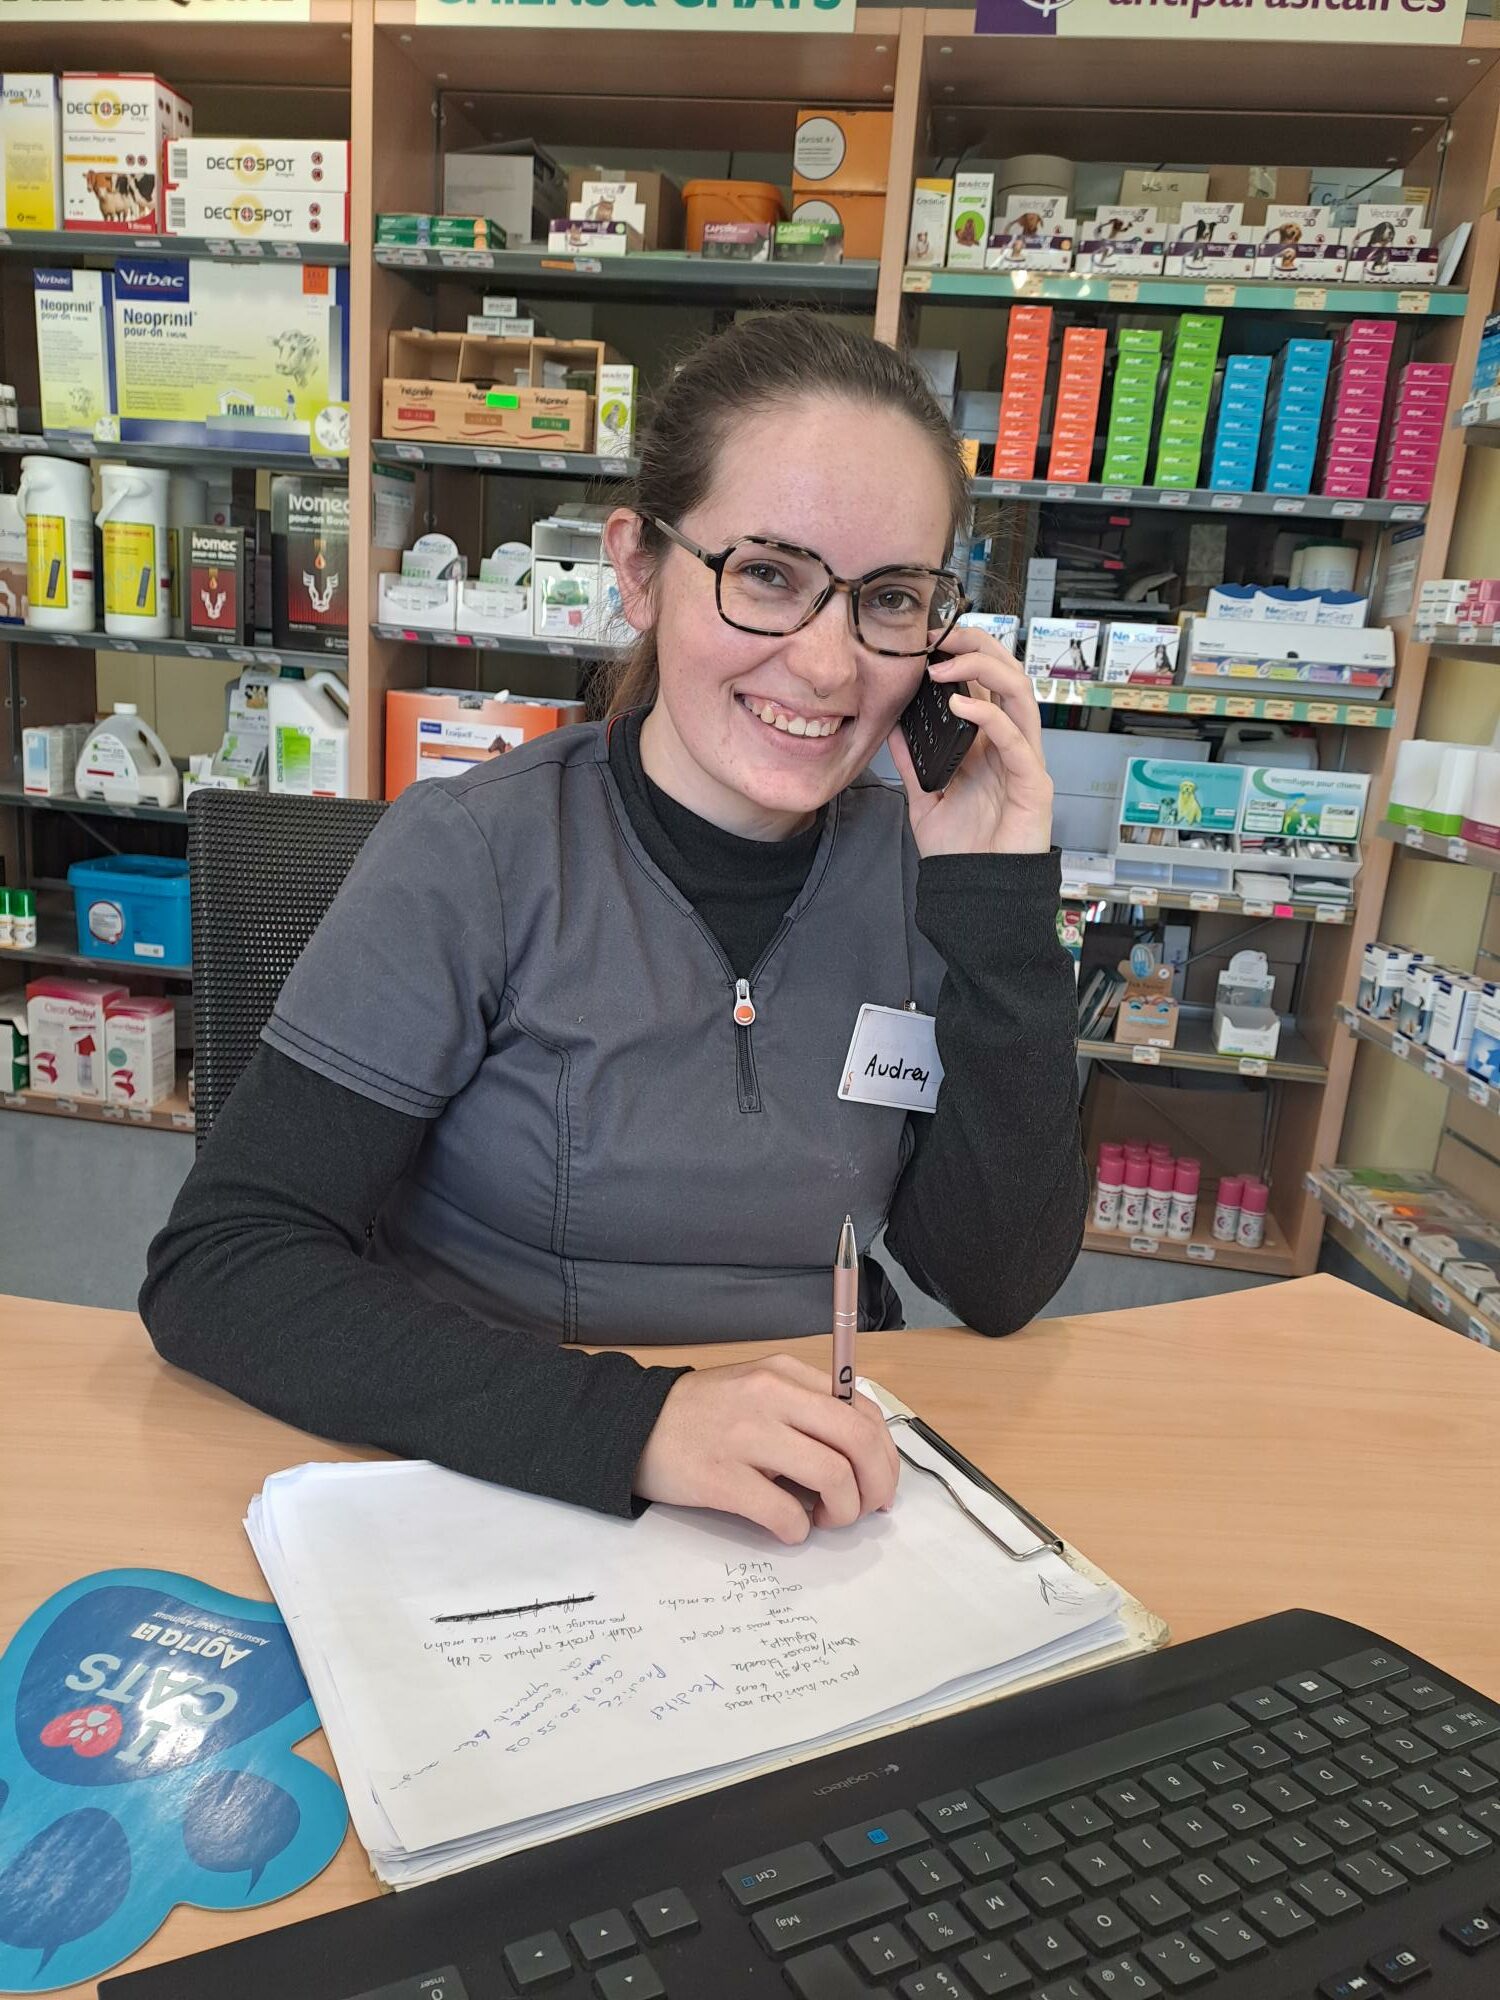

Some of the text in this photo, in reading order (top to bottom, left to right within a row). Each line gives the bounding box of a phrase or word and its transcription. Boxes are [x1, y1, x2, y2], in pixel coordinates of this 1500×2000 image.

[66, 102, 148, 116] DECTOSPOT
[206, 156, 295, 172] DECTOSPOT
[204, 205, 292, 222] DECTOSPOT
[36, 273, 70, 286] Virbac
[119, 267, 184, 288] Virbac
[40, 298, 93, 315] Neoprinil
[123, 308, 194, 329] Neoprinil
[123, 326, 163, 339] pour-on
[227, 403, 255, 417] FARM
[289, 493, 349, 513] Ivomec
[192, 531, 237, 552] Ivomec
[865, 1054, 930, 1092] Audrey
[157, 1628, 253, 1669] Agria
[1370, 1657, 1388, 1667] Ctrl
[65, 1653, 238, 1725] CATS
[1256, 1697, 1271, 1706] Alt
[813, 1772, 880, 1797] Logitech
[938, 1800, 969, 1818] Alt Gr
[756, 1868, 778, 1882] Ctrl
[774, 1914, 801, 1929] Maj
[1101, 1970, 1115, 1981] @
